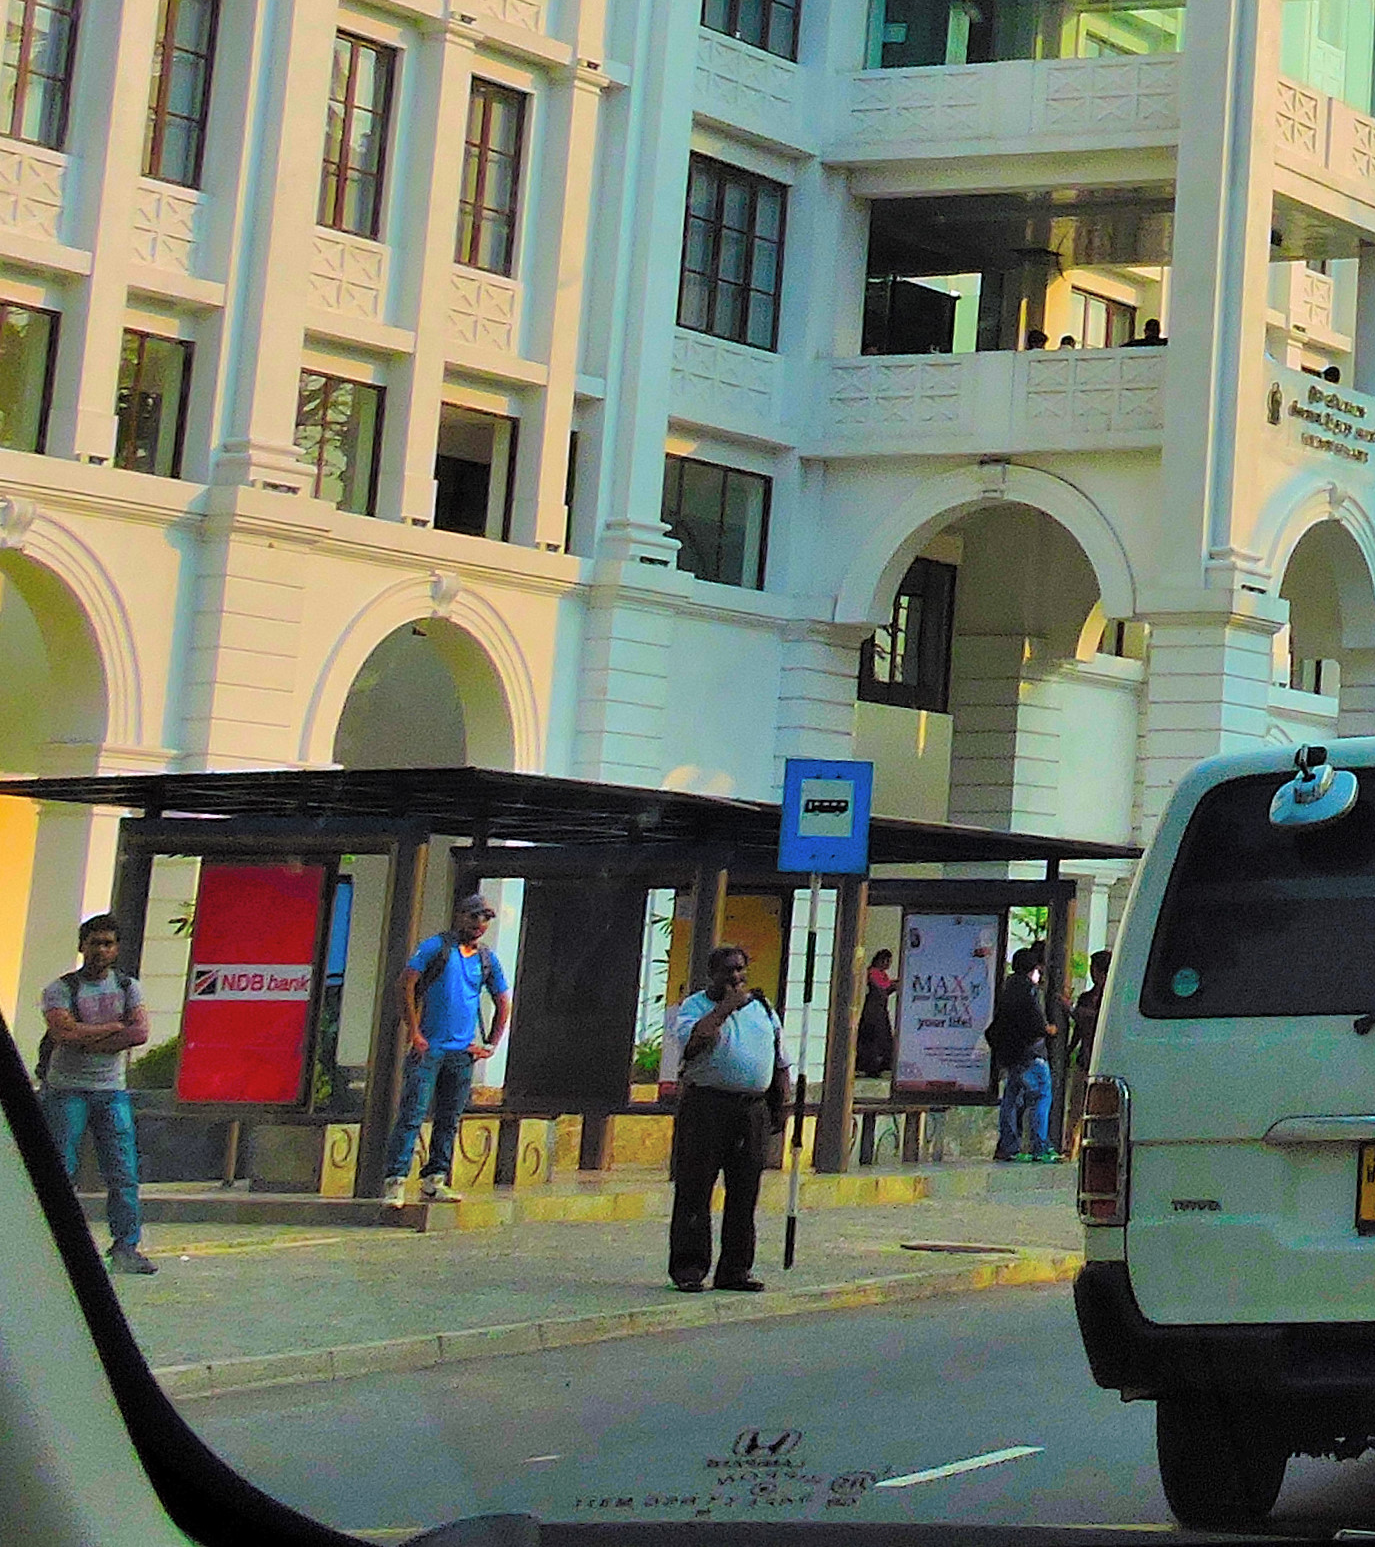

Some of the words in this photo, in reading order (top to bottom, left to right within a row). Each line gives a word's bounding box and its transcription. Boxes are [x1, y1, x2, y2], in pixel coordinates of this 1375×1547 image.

[221, 973, 264, 992] NDB
[267, 974, 311, 992] bank
[912, 974, 966, 994] MAX
[934, 1002, 971, 1017] MAX
